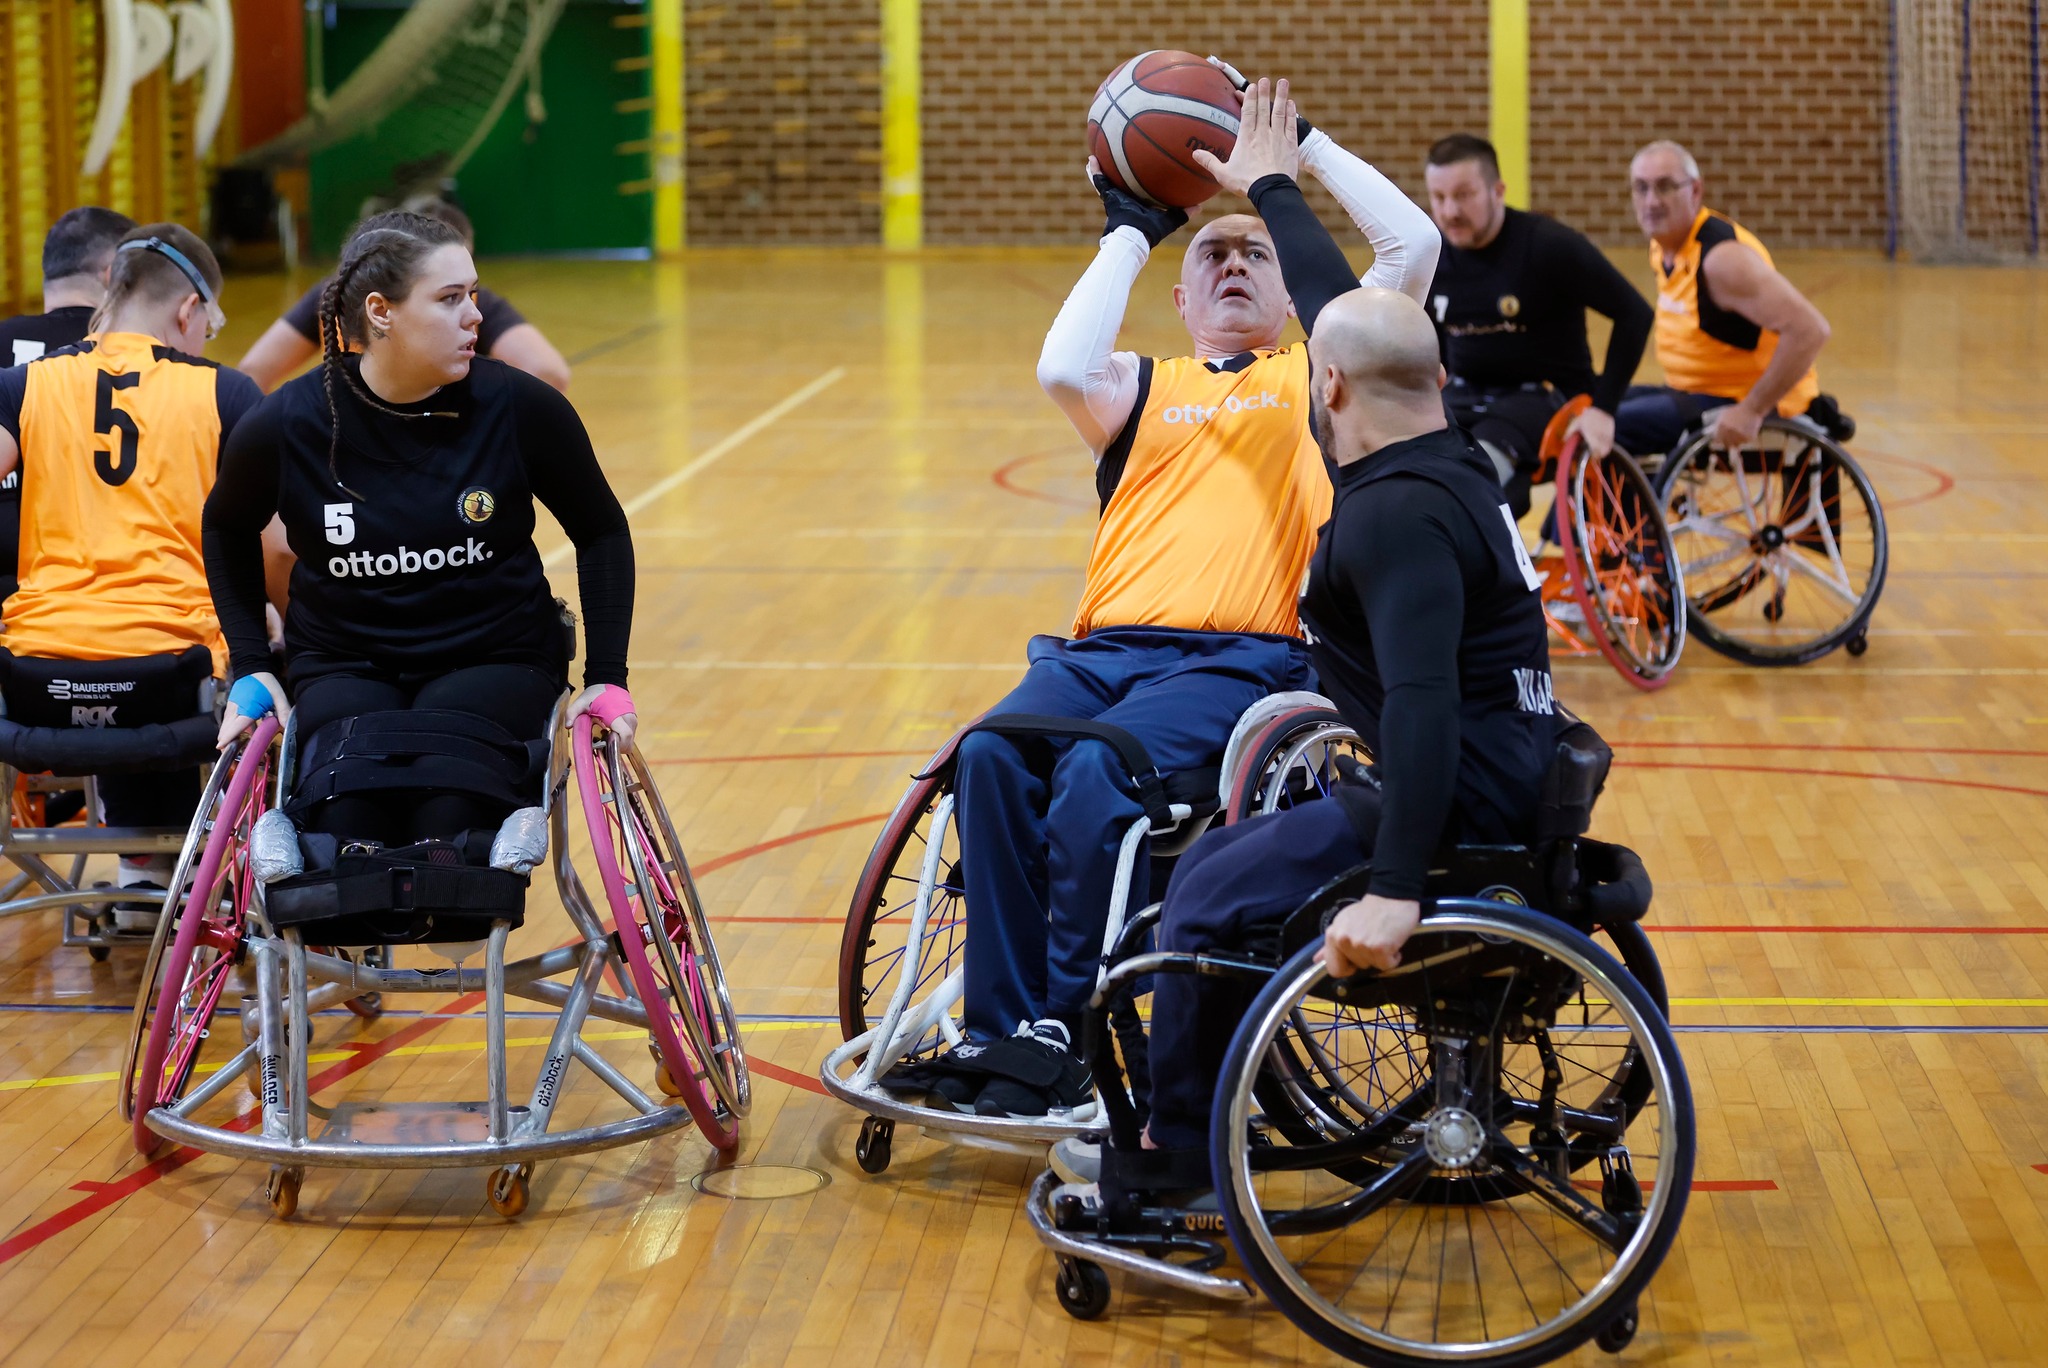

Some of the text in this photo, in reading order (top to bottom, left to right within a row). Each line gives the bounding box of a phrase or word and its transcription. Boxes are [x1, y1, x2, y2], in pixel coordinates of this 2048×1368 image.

[94, 368, 141, 487] 5
[324, 503, 355, 546] 5
[328, 538, 493, 578] ottobock.
[72, 682, 134, 692] BAUERFEIND
